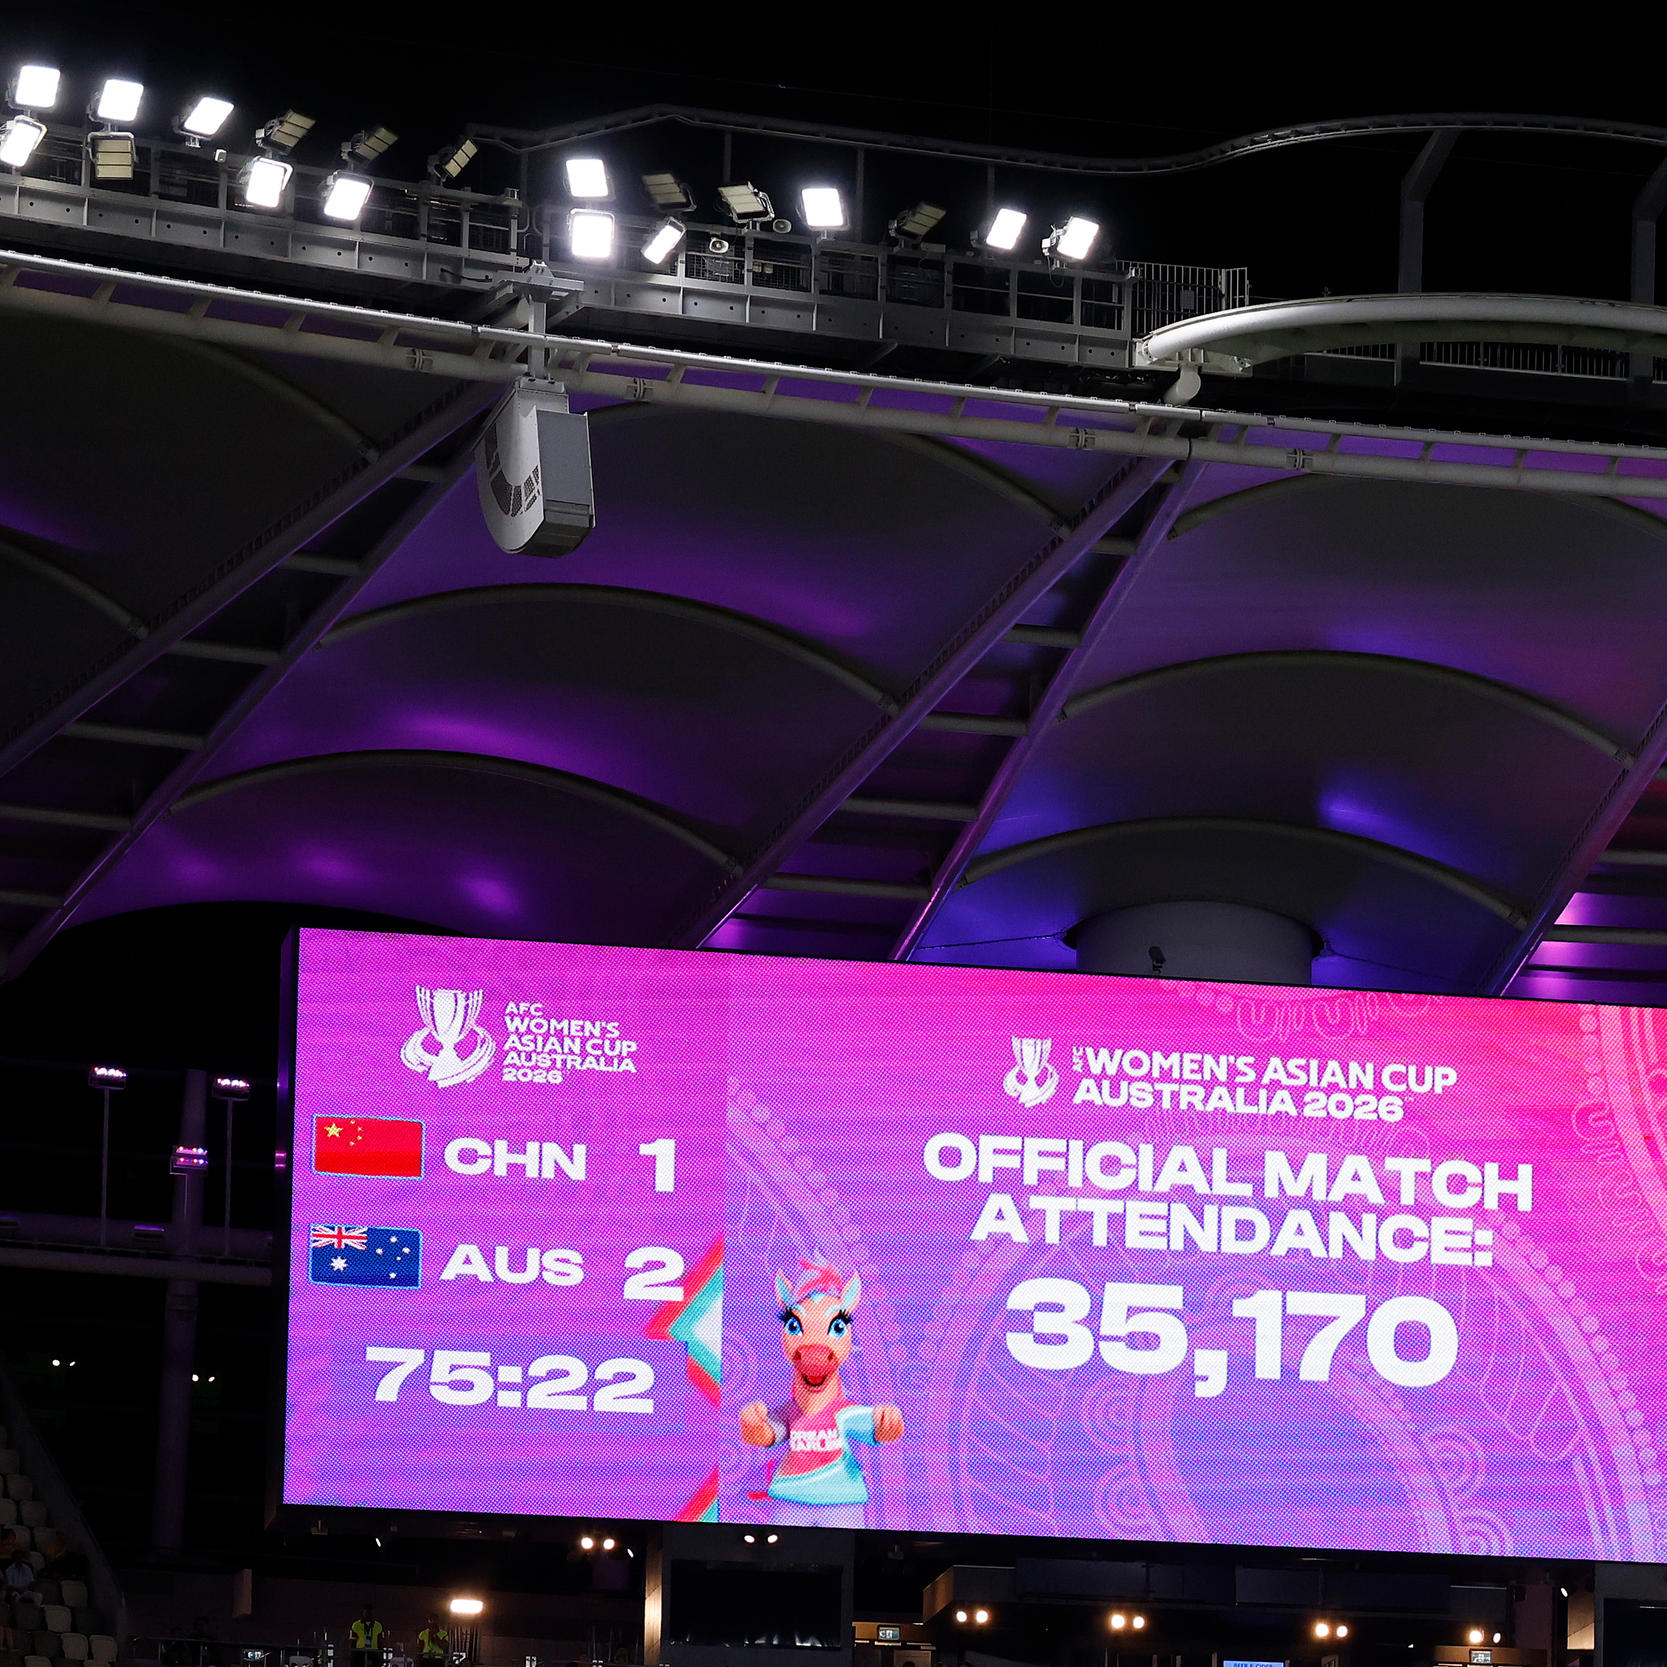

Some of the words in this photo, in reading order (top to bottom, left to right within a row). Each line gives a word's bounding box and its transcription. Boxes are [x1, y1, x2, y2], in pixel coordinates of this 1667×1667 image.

[504, 1016, 620, 1038] WOMEN'S
[505, 1002, 543, 1016] AFC
[503, 1034, 581, 1054] ASIAN
[585, 1038, 637, 1056] CUP
[503, 1051, 637, 1072] AUSTRALIA
[502, 1067, 563, 1084] 2026
[1085, 1047, 1256, 1083] WOMEN'S
[1261, 1058, 1375, 1090] ASIAN
[1381, 1064, 1457, 1094] CUP
[1073, 1078, 1298, 1116] AUSTRALIA
[443, 1137, 586, 1181] CHN
[639, 1139, 676, 1192] 1
[922, 1131, 1252, 1199] OFFICIAL
[1262, 1147, 1533, 1211] MATCH
[969, 1195, 1494, 1266] ATTENDANCE:
[440, 1244, 584, 1286] AUS
[623, 1247, 684, 1301] 2
[1004, 1277, 1459, 1398] 35,170
[366, 1346, 655, 1413] 75:22
